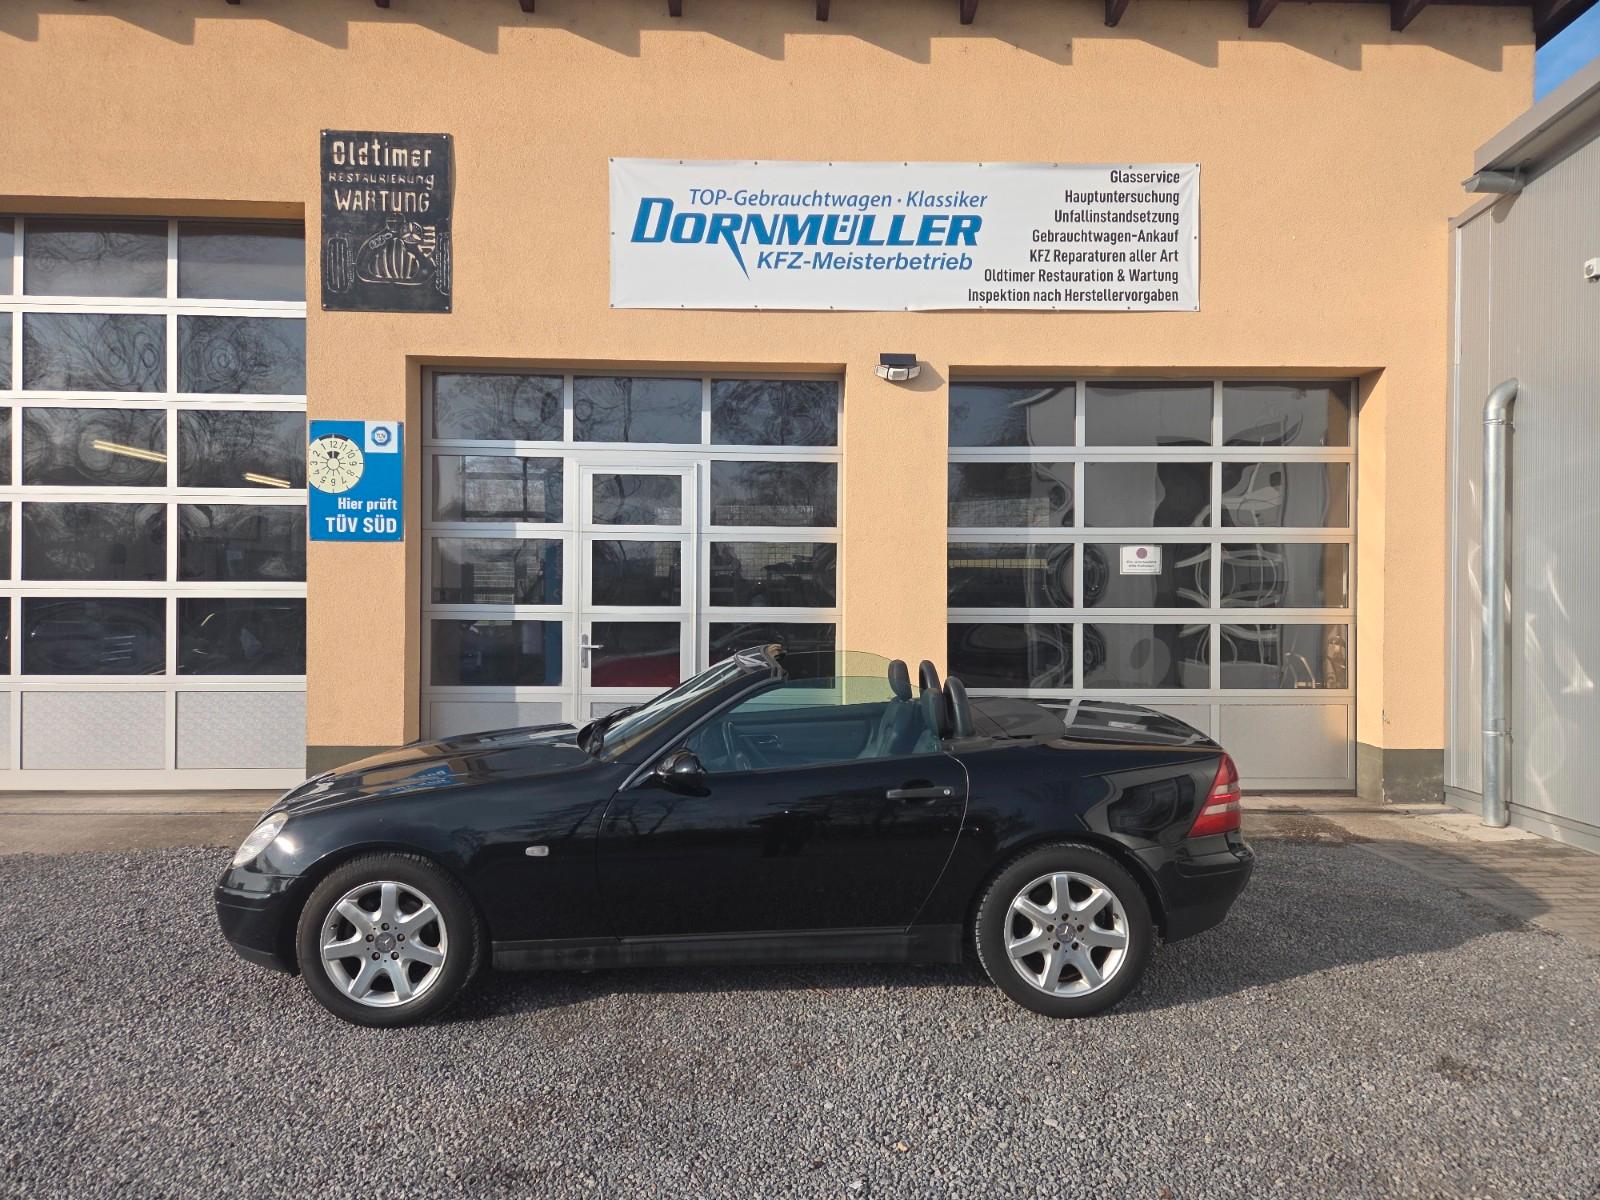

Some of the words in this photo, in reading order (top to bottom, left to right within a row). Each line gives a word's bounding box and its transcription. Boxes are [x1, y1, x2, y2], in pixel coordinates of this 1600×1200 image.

[333, 139, 431, 167] Oldtimer
[1110, 170, 1180, 184] Glasservice
[690, 189, 892, 212] TOP-Gebrauchtwagen
[906, 190, 987, 208] Klassiker
[1065, 190, 1180, 206] Hauptuntersuchung
[1054, 209, 1180, 226] Unfallinstandsetzung
[1032, 229, 1180, 245] Gebrauchtwagen-Ankauf
[757, 251, 973, 270] KFZ-Meisterbetrieb
[1029, 250, 1050, 263] KFZ
[1053, 250, 1126, 265] Reparaturen
[1129, 250, 1157, 263] aller
[1159, 250, 1179, 263] Art
[984, 269, 1035, 283] Oldtimer
[1038, 269, 1114, 283] Restauration
[1117, 270, 1126, 282] &
[1129, 270, 1179, 285] Wartung
[968, 288, 1030, 304] Inspektion
[1033, 289, 1062, 302] nach
[1064, 289, 1179, 304] Herstellervorgaben
[329, 441, 338, 449] 12
[346, 449, 356, 459] 10
[320, 476, 327, 484] 5
[346, 469, 355, 477] 8
[330, 478, 336, 486] 6
[338, 497, 363, 510] Hier
[366, 498, 398, 512] prüft
[325, 514, 358, 533] TÜV
[363, 514, 397, 533] SÜD
